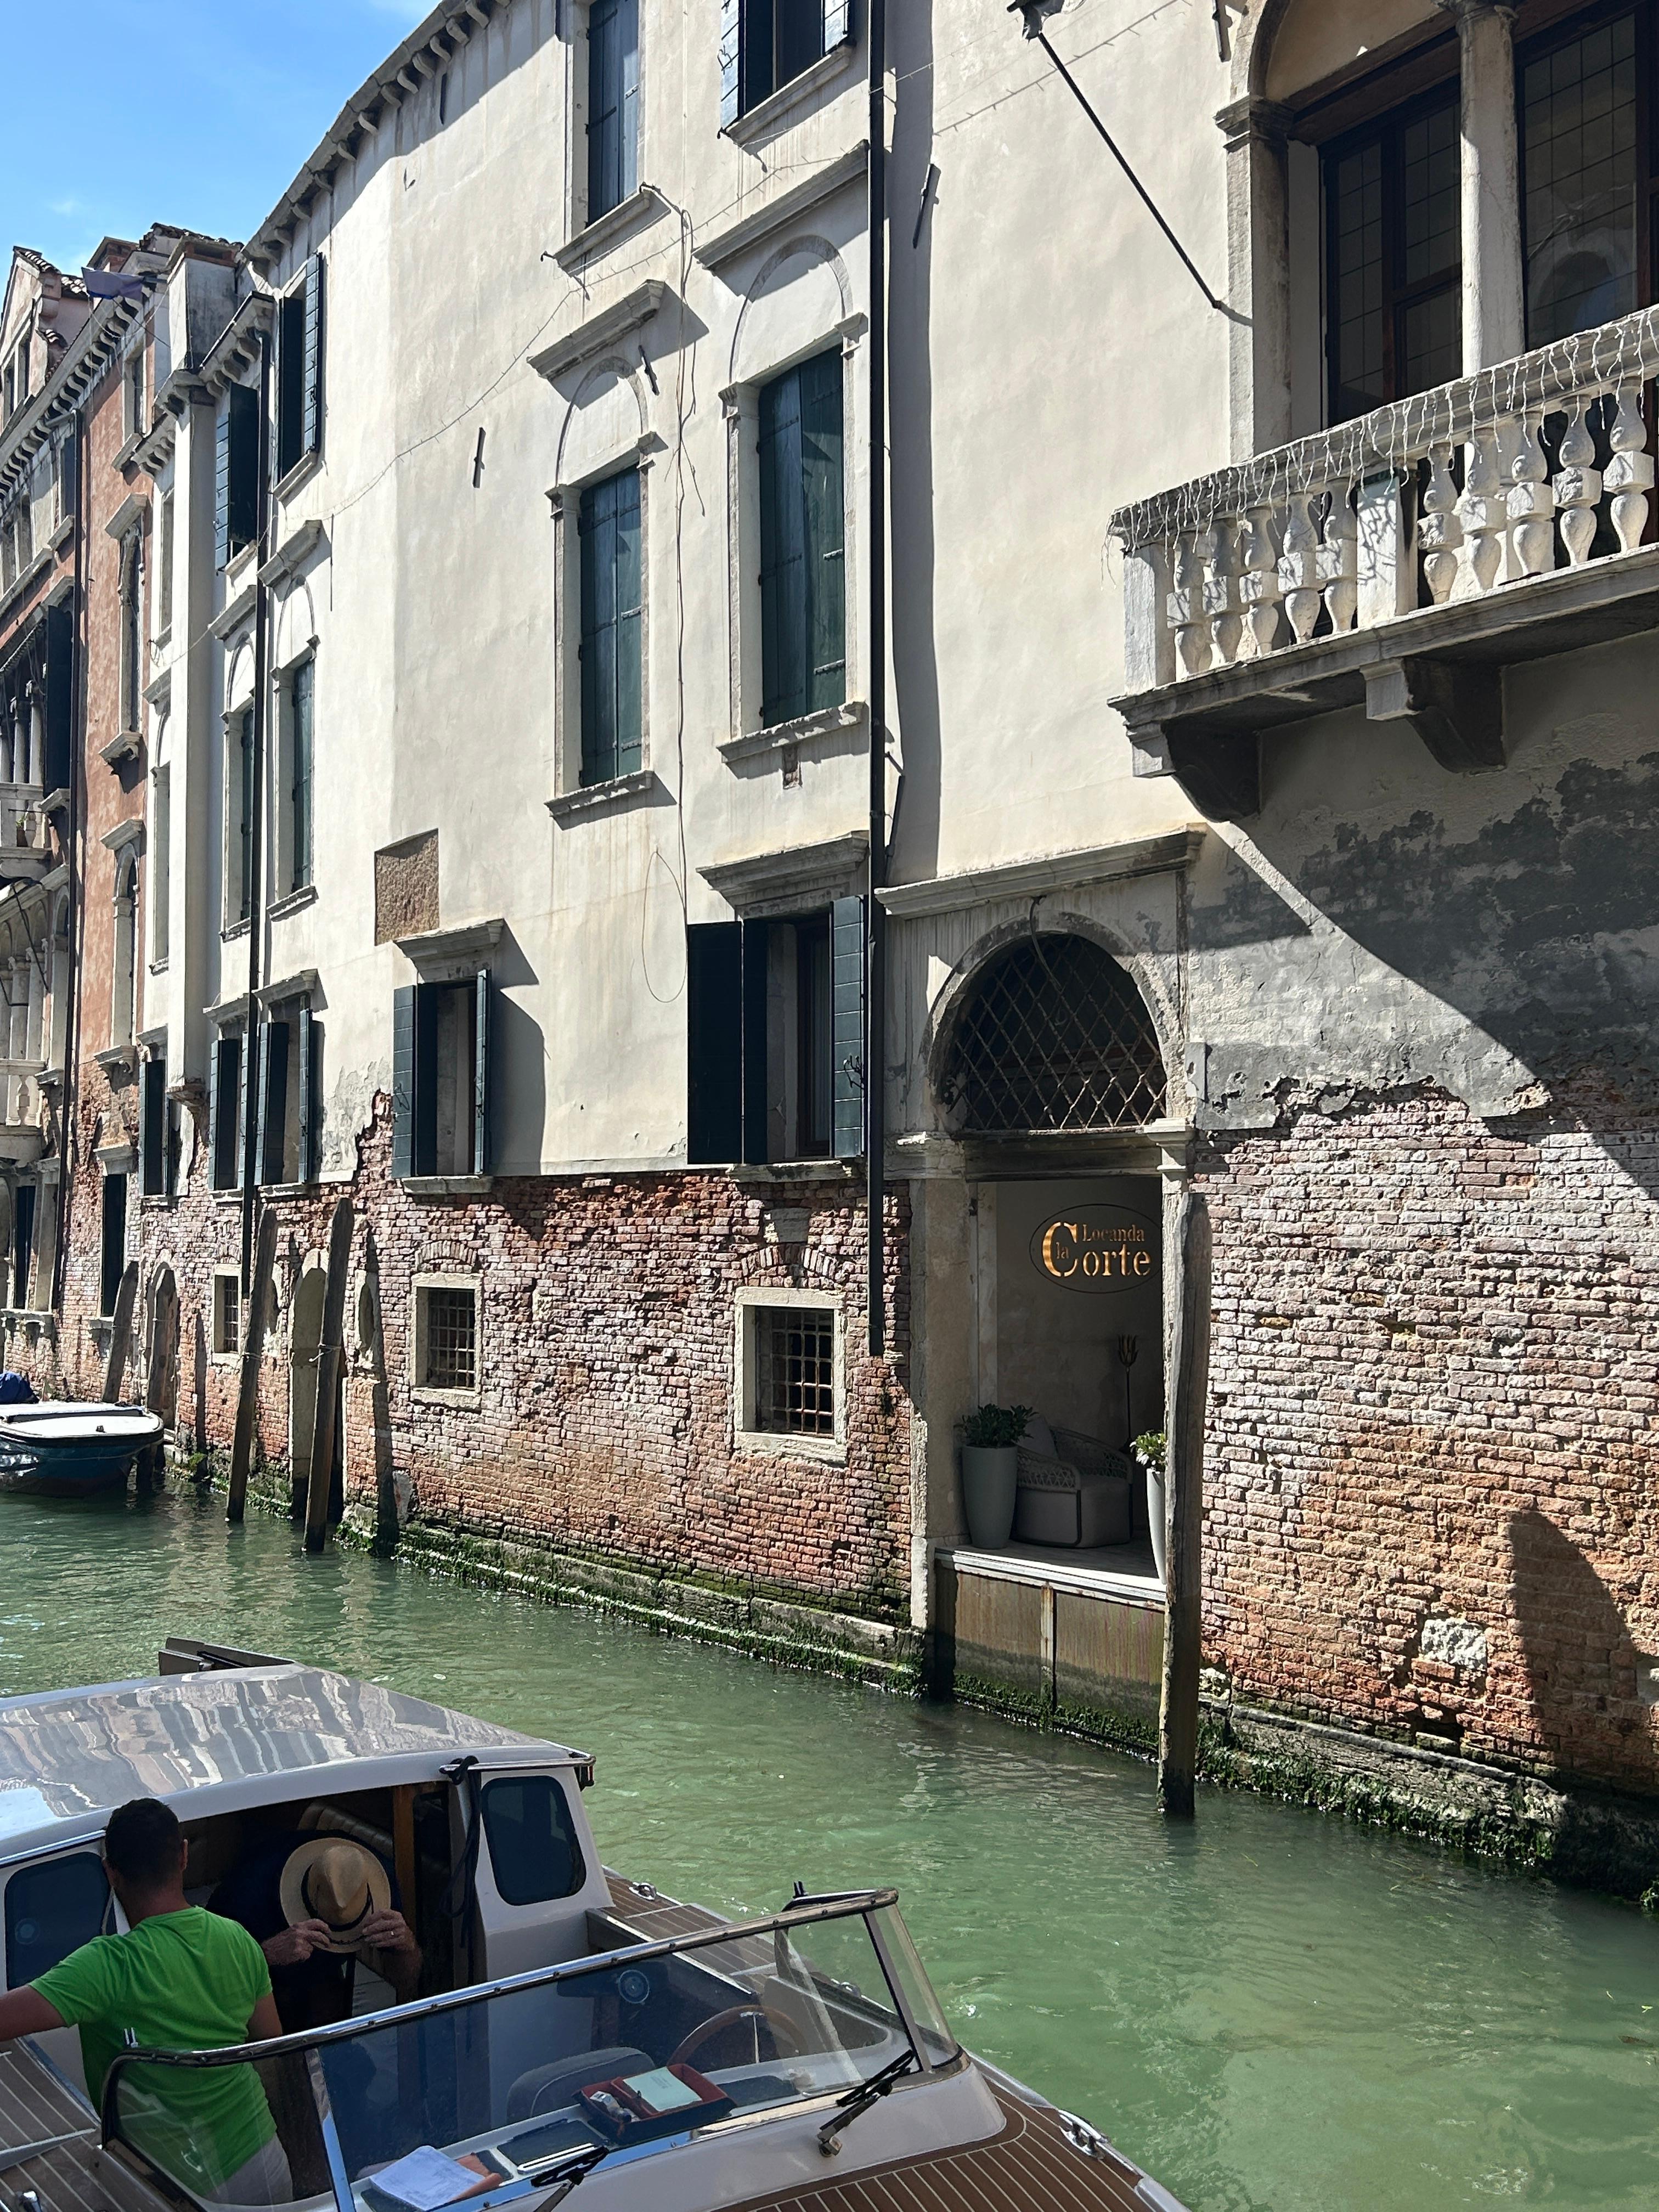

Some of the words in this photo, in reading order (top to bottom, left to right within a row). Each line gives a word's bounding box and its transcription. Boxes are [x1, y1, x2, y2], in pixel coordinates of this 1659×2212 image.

[1082, 1224, 1145, 1242] Locanda
[1042, 1221, 1151, 1277] Corte
[1056, 1242, 1069, 1259] la
